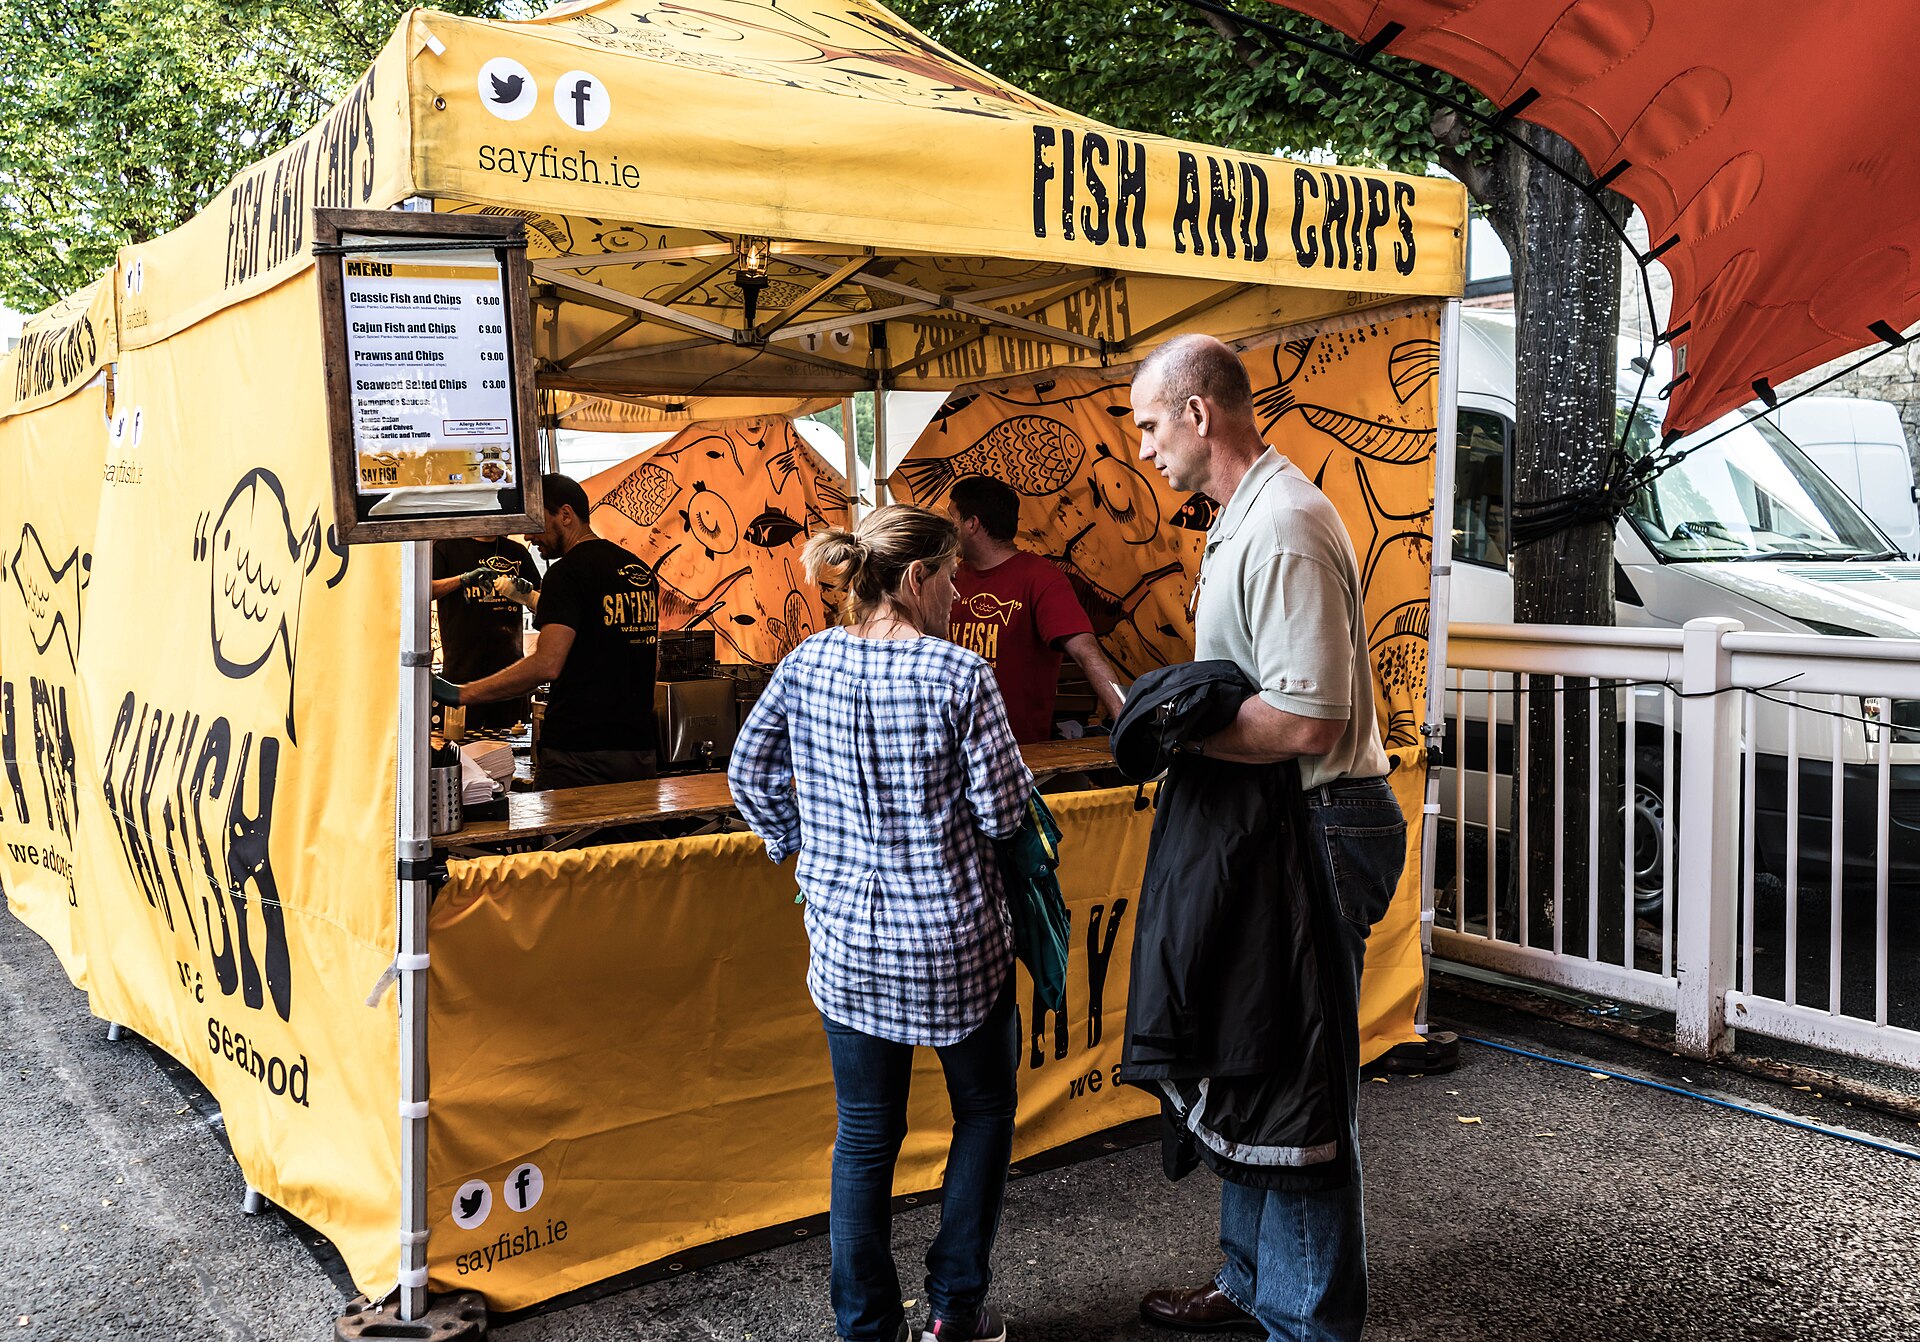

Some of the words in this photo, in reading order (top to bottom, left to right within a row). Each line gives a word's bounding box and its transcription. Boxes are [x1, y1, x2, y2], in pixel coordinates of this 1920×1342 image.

[478, 144, 641, 189] sayfish.ie
[224, 169, 267, 291] FISH
[267, 139, 310, 272] AND
[314, 64, 376, 208] CHIPS
[1032, 124, 1147, 249] FISH
[1173, 150, 1269, 262] AND
[1291, 167, 1417, 277] CHIPS
[347, 262, 393, 277] MENU
[349, 292, 389, 303] Classic
[390, 293, 411, 304] Fish
[412, 293, 432, 304] and
[433, 294, 462, 305] Chips
[352, 322, 383, 334] Cajun
[384, 322, 406, 333] Fish
[407, 322, 426, 333] and
[428, 323, 457, 334] Chips
[354, 350, 393, 361] Prawns
[394, 350, 414, 361] and
[415, 350, 444, 362] Chips
[356, 379, 404, 390] Seaweed
[405, 379, 438, 390] Salted
[439, 379, 468, 391] Chips
[357, 398, 400, 407] Homemade
[361, 468, 378, 482] SAY
[378, 467, 398, 481] FISH
[961, 622, 1000, 659] FISH
[6, 842, 40, 866] we
[1069, 1068, 1104, 1100] we
[455, 1218, 568, 1276] sayfish.ie
